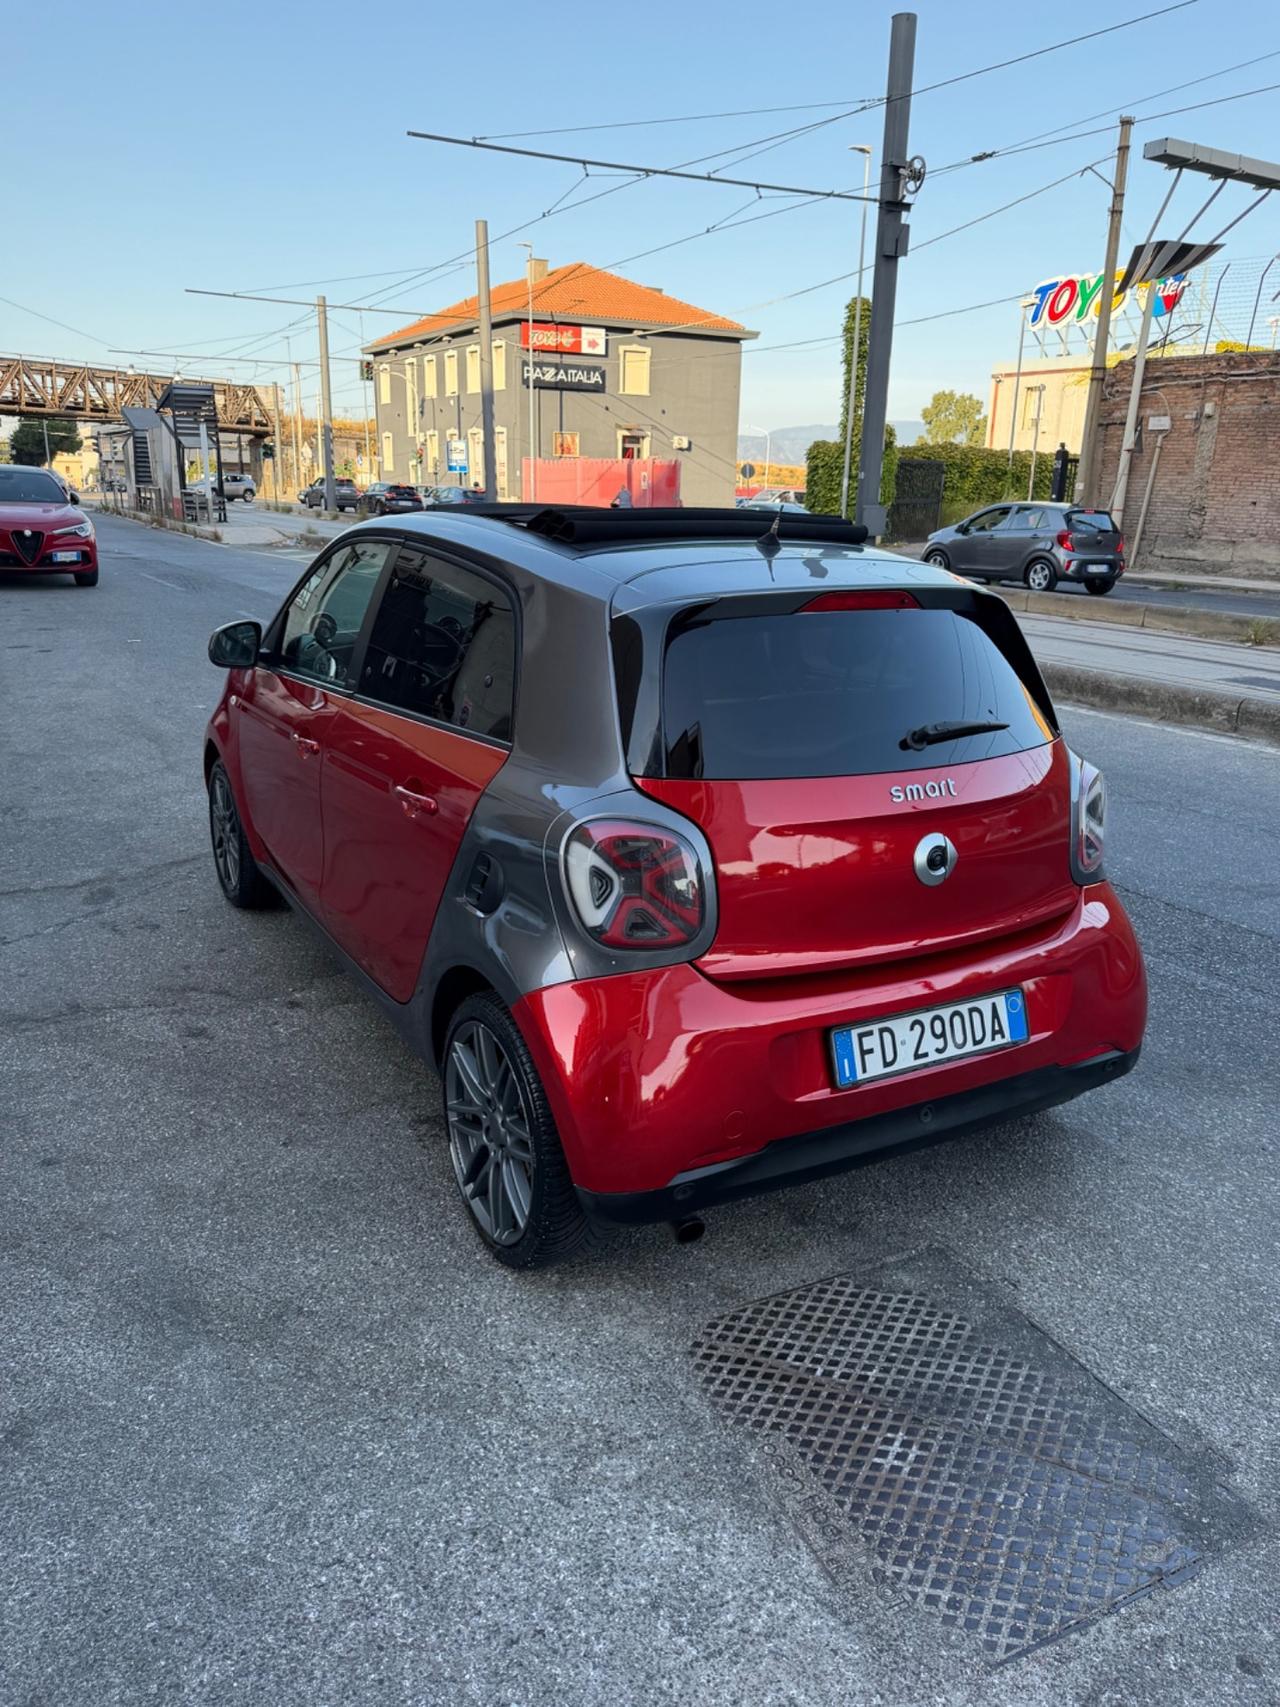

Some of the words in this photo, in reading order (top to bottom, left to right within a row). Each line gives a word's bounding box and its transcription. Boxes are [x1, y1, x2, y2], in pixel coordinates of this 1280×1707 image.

[524, 366, 567, 382] PAZZA
[567, 369, 603, 384] ITALIA
[890, 778, 957, 803] smart
[857, 1026, 898, 1075] FD
[909, 1001, 1006, 1062] 290DA
